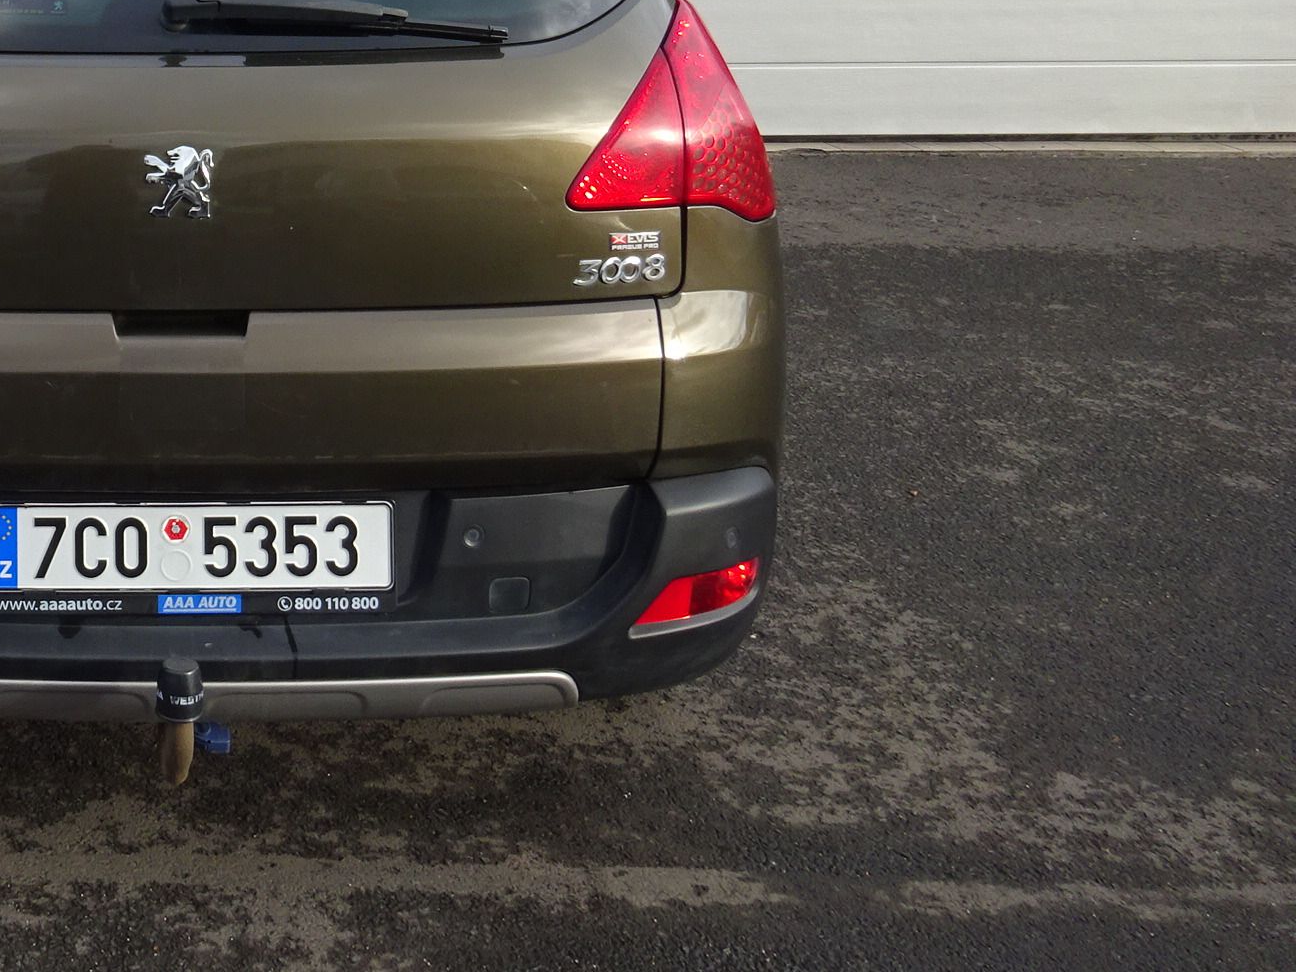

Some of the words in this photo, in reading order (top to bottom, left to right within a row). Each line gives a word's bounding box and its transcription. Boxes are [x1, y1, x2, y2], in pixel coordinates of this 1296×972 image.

[573, 253, 666, 286] 3008
[33, 516, 148, 579] 7C0
[203, 515, 358, 578] 5353
[163, 596, 194, 609] AAA
[198, 596, 236, 609] AUTO
[294, 597, 322, 610] 800
[325, 597, 349, 610] 110
[351, 596, 379, 610] 800
